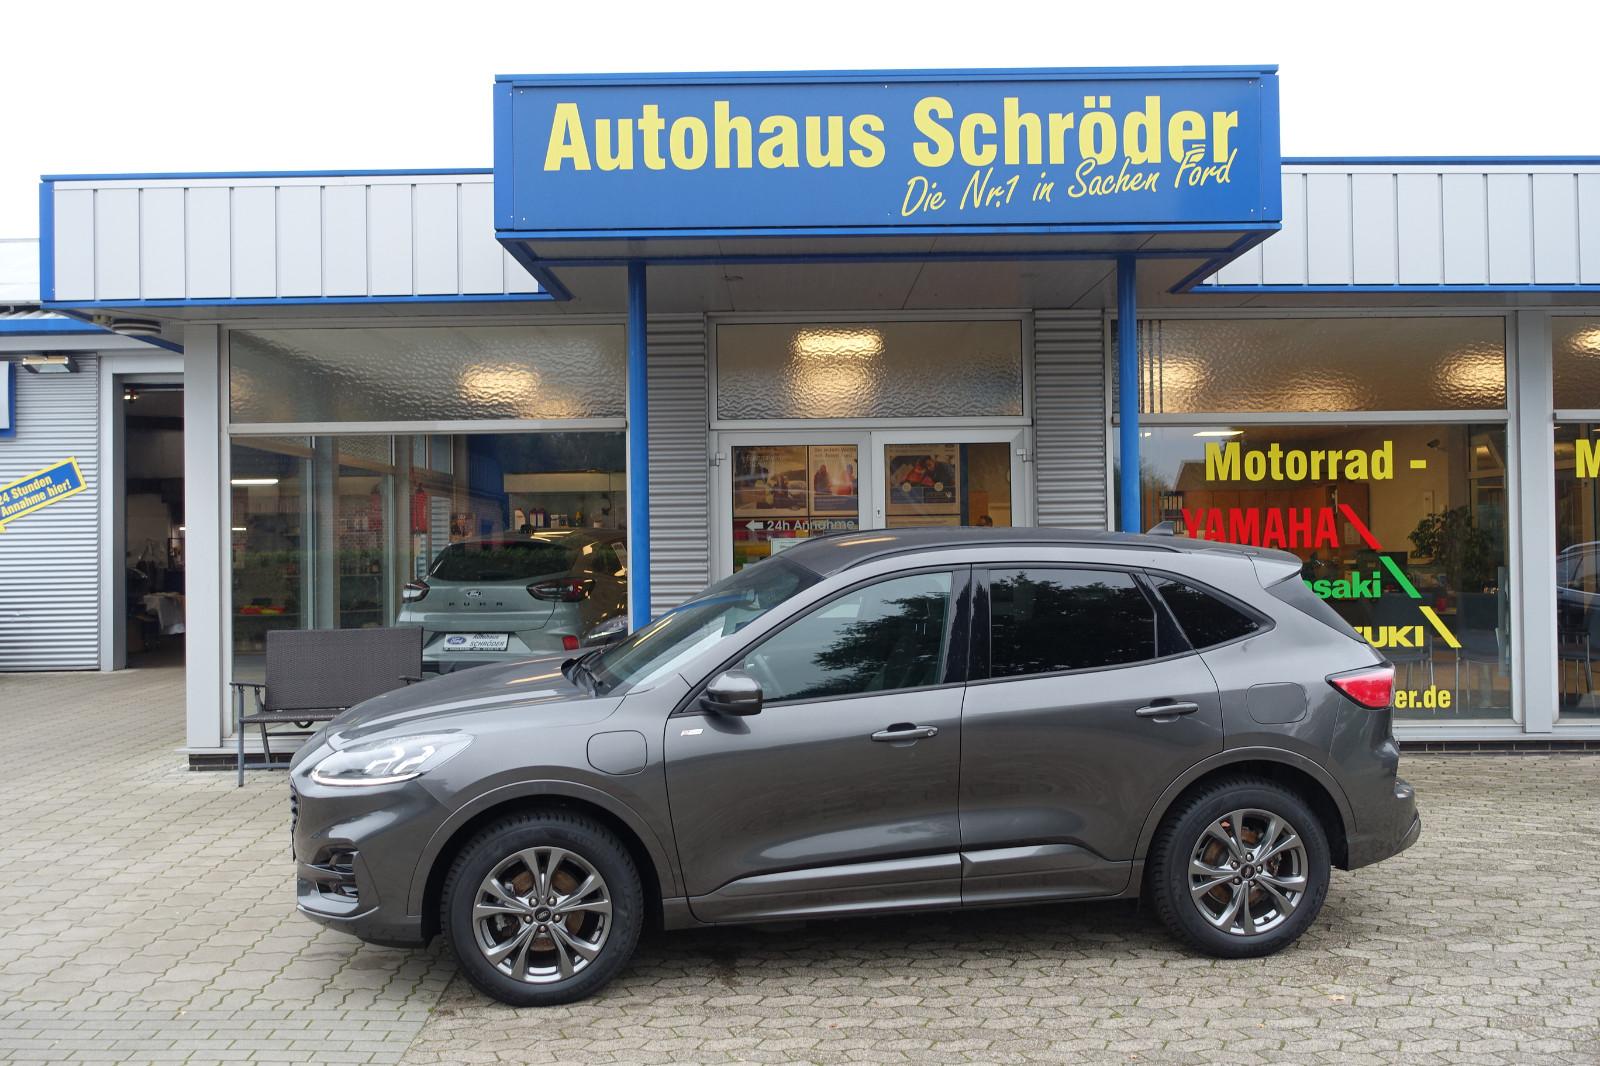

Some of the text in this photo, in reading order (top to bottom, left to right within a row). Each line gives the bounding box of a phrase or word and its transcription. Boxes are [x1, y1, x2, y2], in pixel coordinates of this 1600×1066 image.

[543, 95, 1239, 172] Autohaus Schröder
[901, 175, 946, 217] Die
[1032, 171, 1055, 203] in
[1068, 157, 1161, 199] Sachen
[1174, 143, 1238, 188] Ford
[1204, 440, 1394, 481] Motorrad
[1, 478, 72, 517] Annahme hier!
[11, 476, 52, 499] Stunden
[767, 519, 855, 531] 24h Annahme
[1181, 507, 1340, 549] YAMAHA
